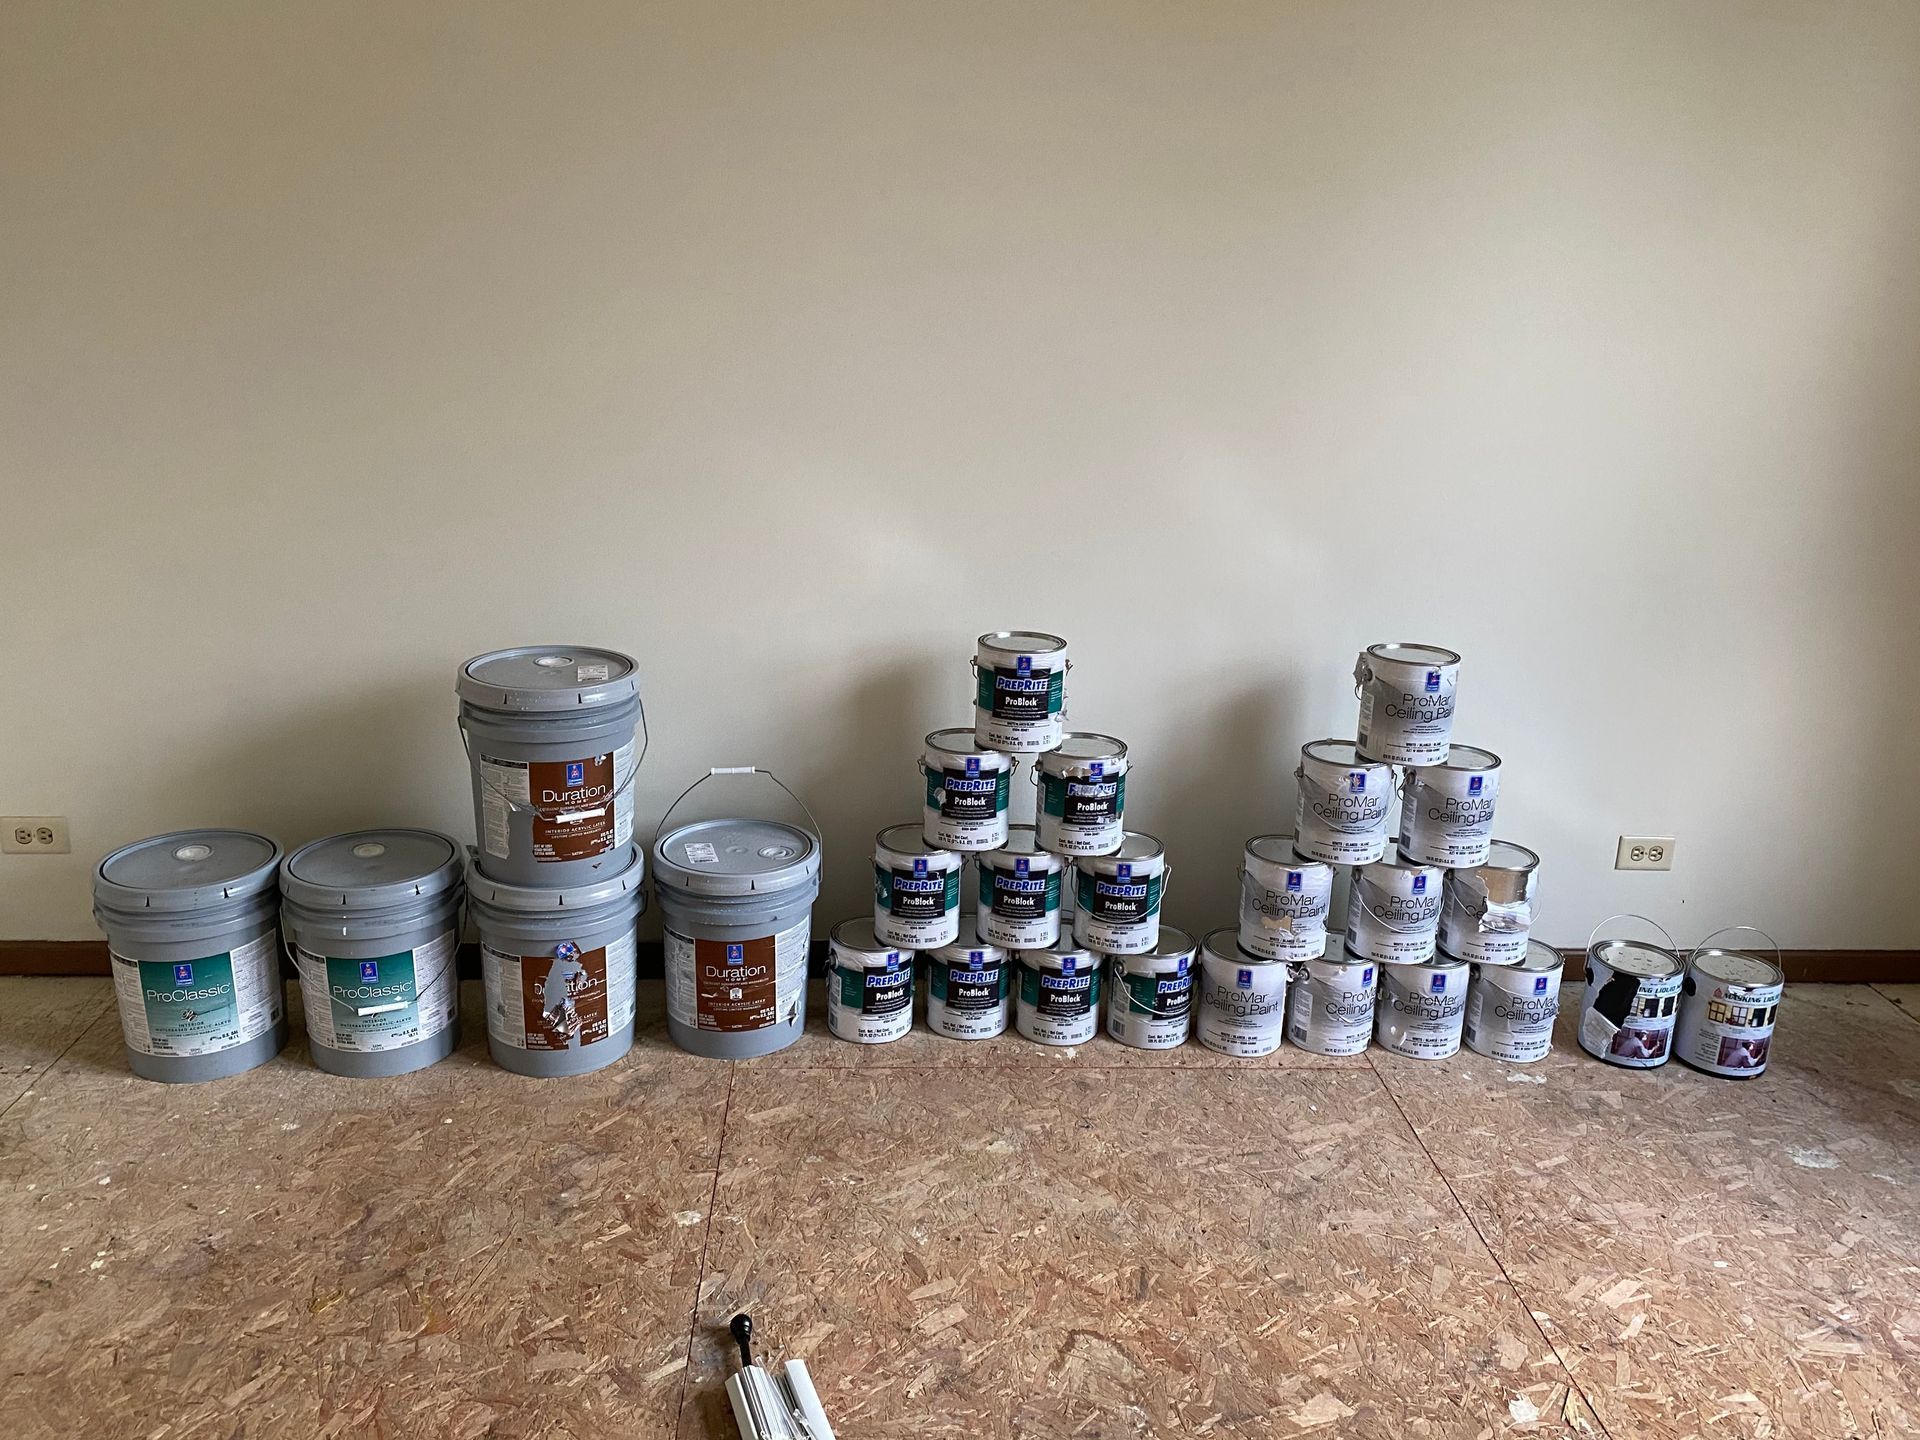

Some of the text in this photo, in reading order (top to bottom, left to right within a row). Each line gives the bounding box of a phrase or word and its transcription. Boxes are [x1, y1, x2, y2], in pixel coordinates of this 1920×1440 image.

[1005, 697, 1037, 706] ProBlock
[1403, 693, 1451, 707] ProMar
[1385, 704, 1433, 723] Ceiling
[542, 784, 606, 803] Duration
[1328, 793, 1379, 808] ProMar
[954, 797, 987, 806] ProBlock
[1077, 802, 1109, 811] ProBlock
[1445, 798, 1493, 811] ProMar
[1313, 802, 1359, 824] Ceiling
[1428, 808, 1476, 826] Ceiling
[903, 896, 935, 906] ProBlock
[1003, 896, 1035, 906] ProBlock
[1266, 890, 1317, 906] ProMar
[1390, 896, 1437, 909] ProMar
[1105, 901, 1137, 911] ProBlock
[1252, 898, 1326, 919] Ceiling Paint
[1373, 905, 1419, 924] Ceiling
[706, 965, 766, 978] Duration
[146, 984, 231, 1002] ProClassic
[333, 981, 412, 998] ProClassic
[876, 987, 904, 1001] ProBlock
[958, 987, 990, 996] ProBlock
[1217, 985, 1269, 1003] ProMar
[1050, 994, 1081, 1003] ProBlock
[1205, 992, 1278, 1017] Ceiling Paint
[1409, 992, 1457, 1006] ProMar
[1326, 1002, 1368, 1015] Ceiling
[1393, 1000, 1439, 1020] Ceiling
[1495, 1005, 1540, 1024] Ceiling
